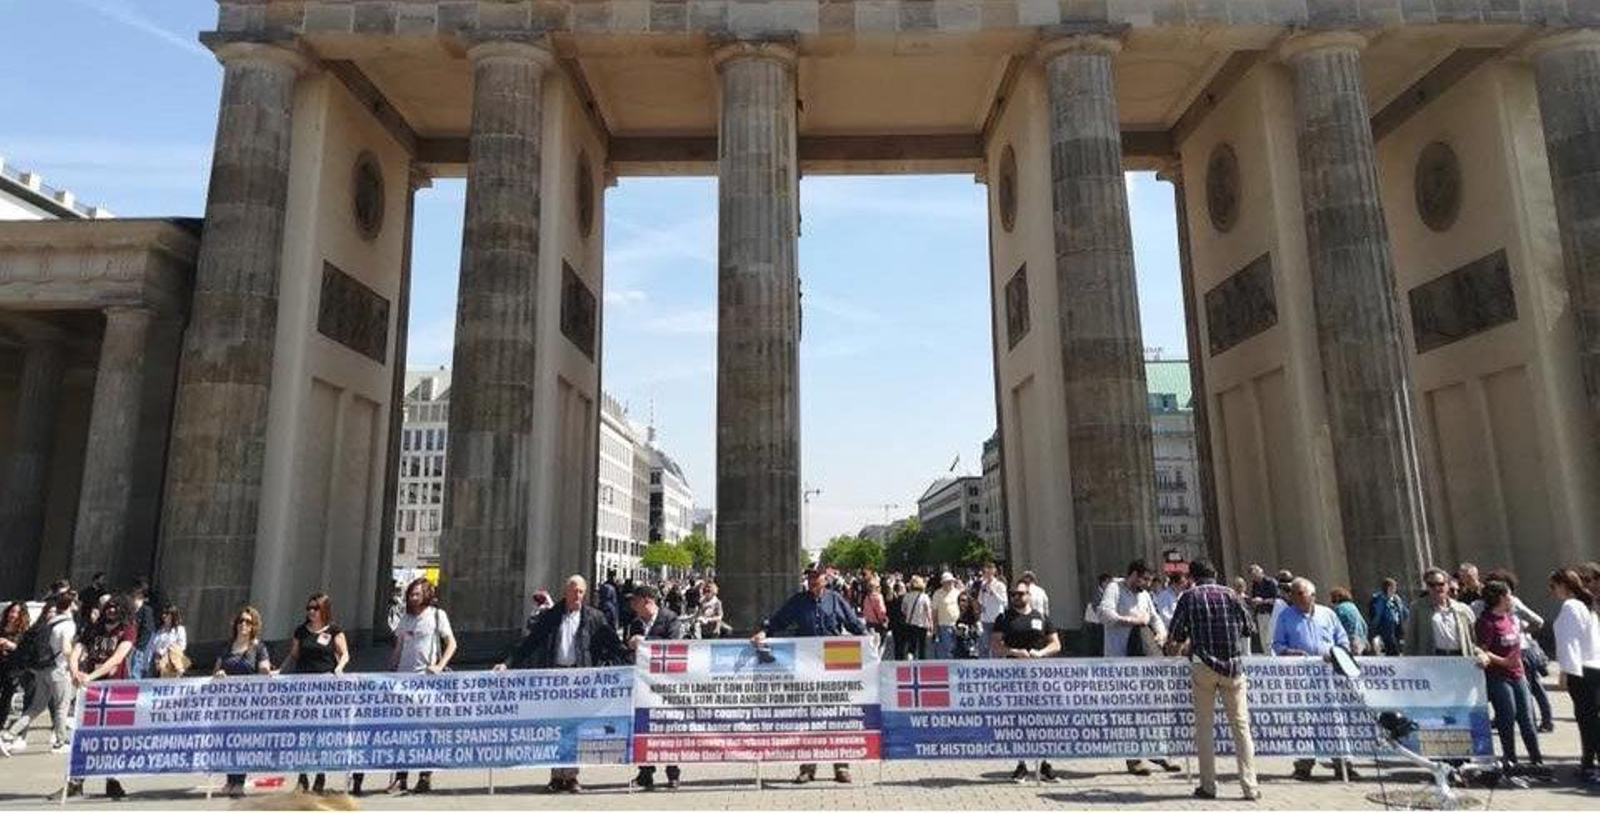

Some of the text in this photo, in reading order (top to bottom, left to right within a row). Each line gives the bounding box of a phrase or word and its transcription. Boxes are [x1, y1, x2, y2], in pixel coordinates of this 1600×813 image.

[957, 667, 970, 679] VI
[972, 667, 1027, 679] SPANSKE
[1030, 666, 1088, 678] SJØMENN
[1091, 666, 1138, 678] KREVER
[1142, 665, 1193, 677] INNFRID
[152, 671, 620, 696] NEI TIL FORTSATT DISKRIMINERING AV SPANSKE SJØMENN ETTER 40 ÅRS
[957, 680, 1040, 693] RETTIGHETER
[1043, 680, 1061, 693] OG
[1063, 679, 1138, 692] OPPREISING
[1140, 679, 1165, 692] FOR
[1246, 679, 1264, 690] OM
[1267, 679, 1283, 690] ER
[1364, 679, 1389, 690] OSS
[1392, 679, 1431, 691] ETTER
[151, 697, 215, 710] TJENESTE
[218, 697, 247, 708] IDEN
[249, 695, 304, 707] NORSKE
[306, 692, 414, 706] HANDELSFLÅTEN
[417, 694, 431, 704] VI
[433, 692, 486, 704] KREVER
[489, 688, 516, 702] VÅR
[519, 688, 598, 701] HISTORISKE
[958, 695, 974, 708] 40
[978, 693, 1002, 707] ÅRS
[1005, 694, 1063, 707] TJENESTE
[1065, 694, 1070, 706] I
[1073, 694, 1098, 706] DEN
[1100, 694, 1151, 706] NORSKE
[1260, 692, 1284, 704] DET
[1287, 692, 1303, 704] ER
[1305, 692, 1321, 704] EN
[150, 704, 519, 723] TIL LIKE RETTIGHETER FOR LIKT ARBEID DET ER EN SKAM!
[649, 708, 686, 721] Norway
[714, 708, 752, 721] country
[909, 714, 930, 728] WE
[931, 714, 983, 728] DEMAND
[985, 714, 1015, 727] THAT
[1017, 714, 1071, 726] NORWAY
[1073, 713, 1108, 726] GIVES
[1110, 713, 1134, 725] THE
[1180, 712, 1196, 724] TO
[1254, 711, 1271, 725] TO
[1274, 711, 1296, 725] THE
[1298, 711, 1347, 724] SPANISH
[80, 727, 561, 752] NO TO DISCRIMINATION COMMITTED BY NORWAY AGAINST THE SPANISH SAILORS
[993, 728, 1024, 741] WHO
[1027, 727, 1080, 740] WORKED
[1082, 727, 1101, 740] ON
[1103, 726, 1137, 740] THEIR
[1140, 726, 1172, 739] FLEET
[1261, 724, 1290, 738] TIME
[1292, 724, 1316, 737] FOR
[1317, 724, 1373, 737] REDRESS
[915, 743, 938, 756] THE
[941, 743, 1011, 756] HISTORICAL
[1013, 741, 1073, 755] INJUSTICE
[1074, 741, 1139, 755] COMMITED
[1142, 741, 1159, 754] BY
[1296, 739, 1315, 752] ON
[1317, 738, 1344, 752] YOU
[128, 754, 145, 769] 40
[148, 753, 189, 768] YEARS.
[193, 752, 234, 767] EQUAL
[236, 750, 276, 766] WORK,
[278, 750, 318, 765] EQUAL
[372, 748, 393, 763] IT'S
[395, 748, 407, 763] A
[409, 747, 453, 763] SHAME
[455, 747, 475, 762] ON
[477, 746, 503, 761] YOU
[505, 745, 561, 761] NORWAY.
